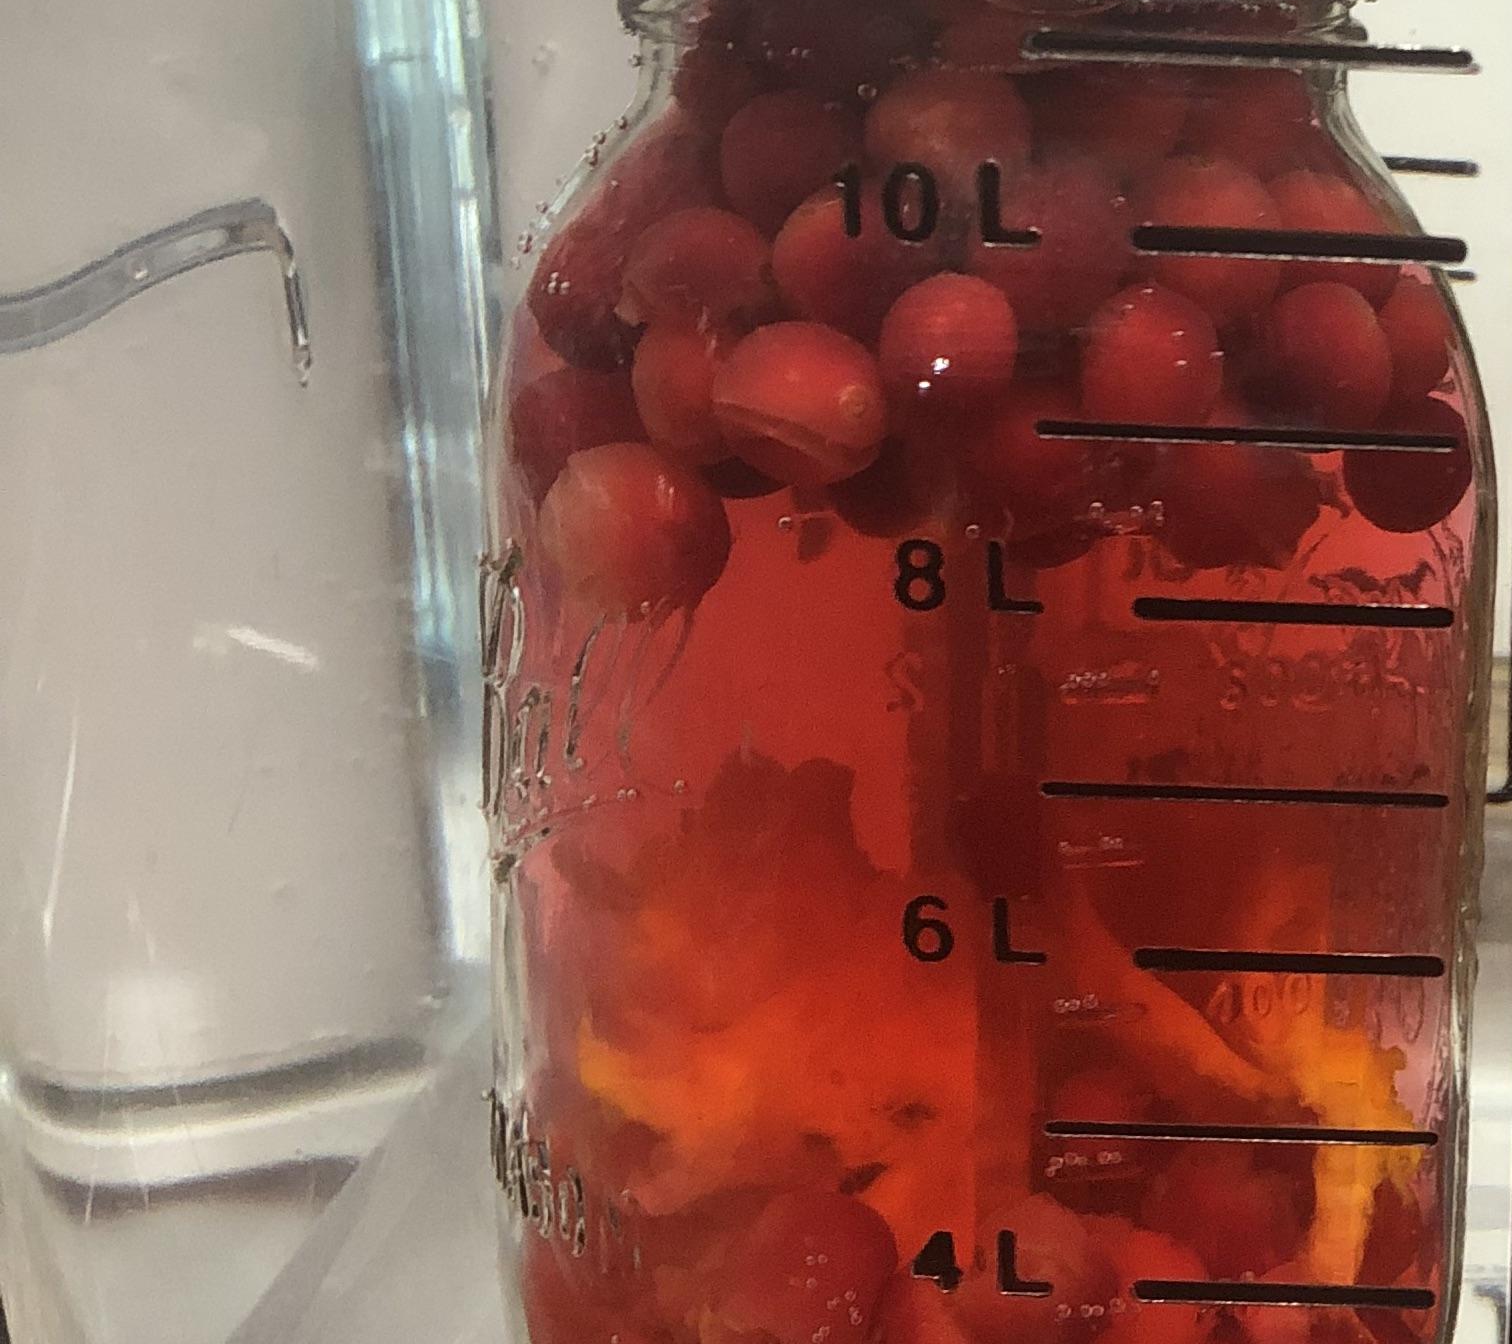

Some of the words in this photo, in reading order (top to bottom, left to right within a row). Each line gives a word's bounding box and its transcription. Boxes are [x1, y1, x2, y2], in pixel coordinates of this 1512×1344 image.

[833, 159, 940, 244] 10
[978, 158, 1043, 246] L
[895, 538, 946, 611] 8
[987, 539, 1044, 614] L
[902, 894, 954, 963] 6
[992, 895, 1047, 964] L
[912, 1230, 963, 1294] 4
[997, 1229, 1054, 1296] L
